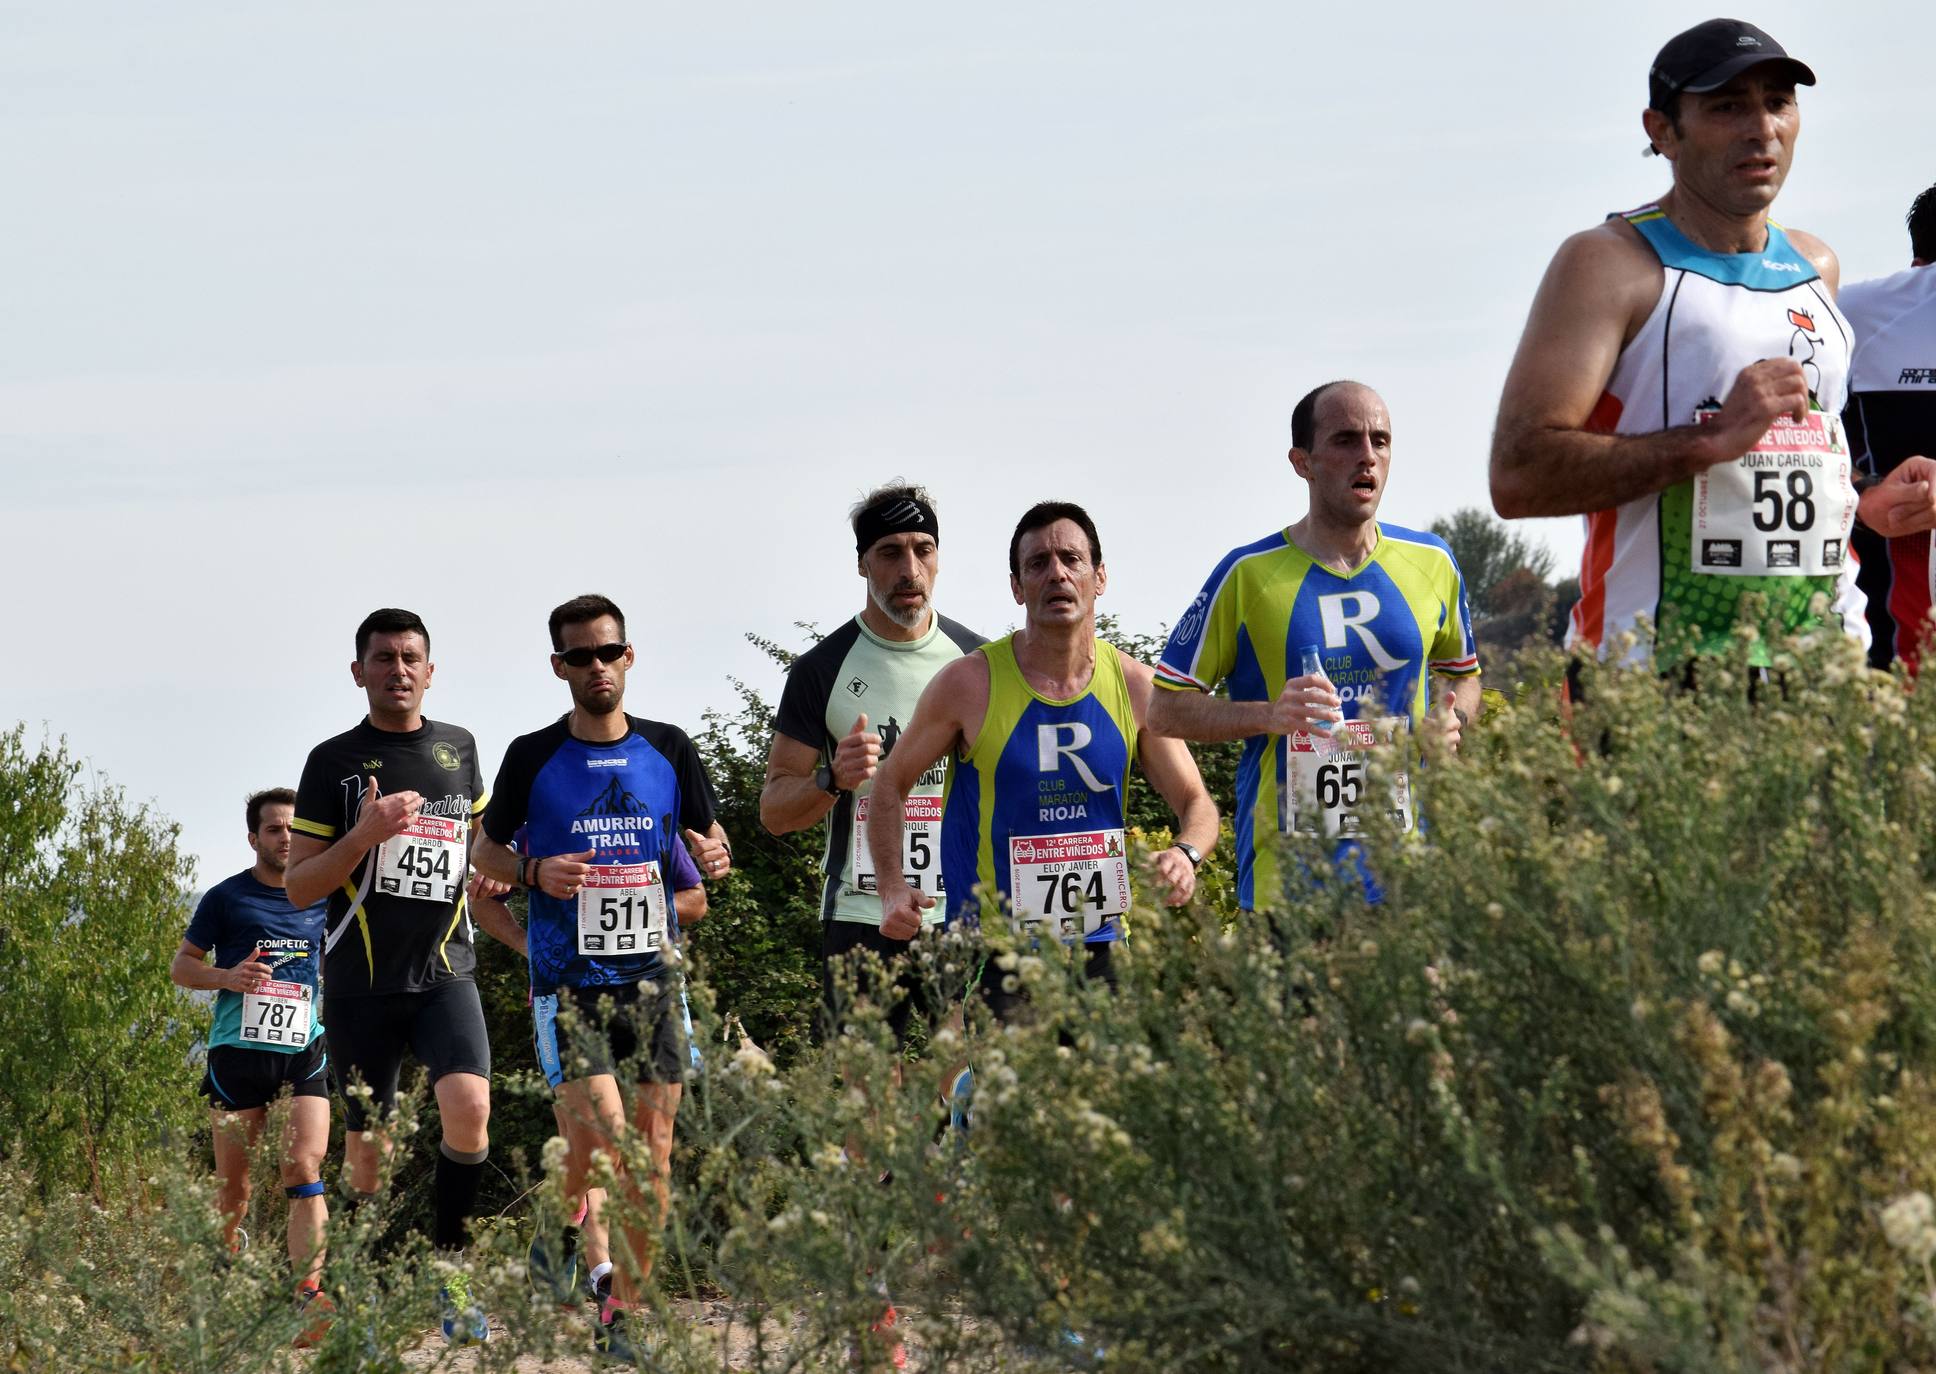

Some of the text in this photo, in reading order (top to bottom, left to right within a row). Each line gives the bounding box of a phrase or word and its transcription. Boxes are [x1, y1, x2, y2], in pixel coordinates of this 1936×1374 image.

[1775, 428, 1824, 446] VIÑEDOS
[1740, 453, 1823, 468] JUAN CARLOS
[1752, 469, 1815, 532] 58
[1317, 591, 1410, 673] R
[1325, 655, 1352, 671] CLUB
[1336, 684, 1376, 703] OJA
[1346, 724, 1371, 733] ARRER
[1347, 732, 1376, 746] VIÑED
[1037, 722, 1116, 793] R
[1038, 779, 1065, 792] CLUB
[1316, 764, 1363, 810] 65
[905, 799, 932, 807] ARRERA
[1039, 790, 1088, 807] MARATÓN
[905, 805, 942, 818] VIÑEDOS
[1039, 804, 1087, 822] RIOJA
[419, 817, 447, 828] CARRERA
[570, 816, 653, 834] AMURRIO
[905, 822, 928, 831] RIQUE
[424, 825, 453, 838] VIÑEDOS
[412, 837, 442, 848] RICARDO
[587, 832, 640, 848] TRAIL
[1058, 836, 1093, 847] CARRERA
[905, 832, 931, 870] 5
[1036, 843, 1104, 860] ENTRE VIÑEDOS
[397, 845, 451, 880] 454
[1043, 860, 1098, 873] ELOY JAVIER
[601, 873, 648, 885] ENTRE VIÑES
[1115, 861, 1128, 909] CENICERO
[620, 888, 638, 897] ABEL
[1036, 870, 1107, 915] 764
[600, 896, 648, 932] 511
[256, 939, 309, 949] COMPETIC
[269, 952, 296, 970] UNNER
[258, 1001, 297, 1029] 787
